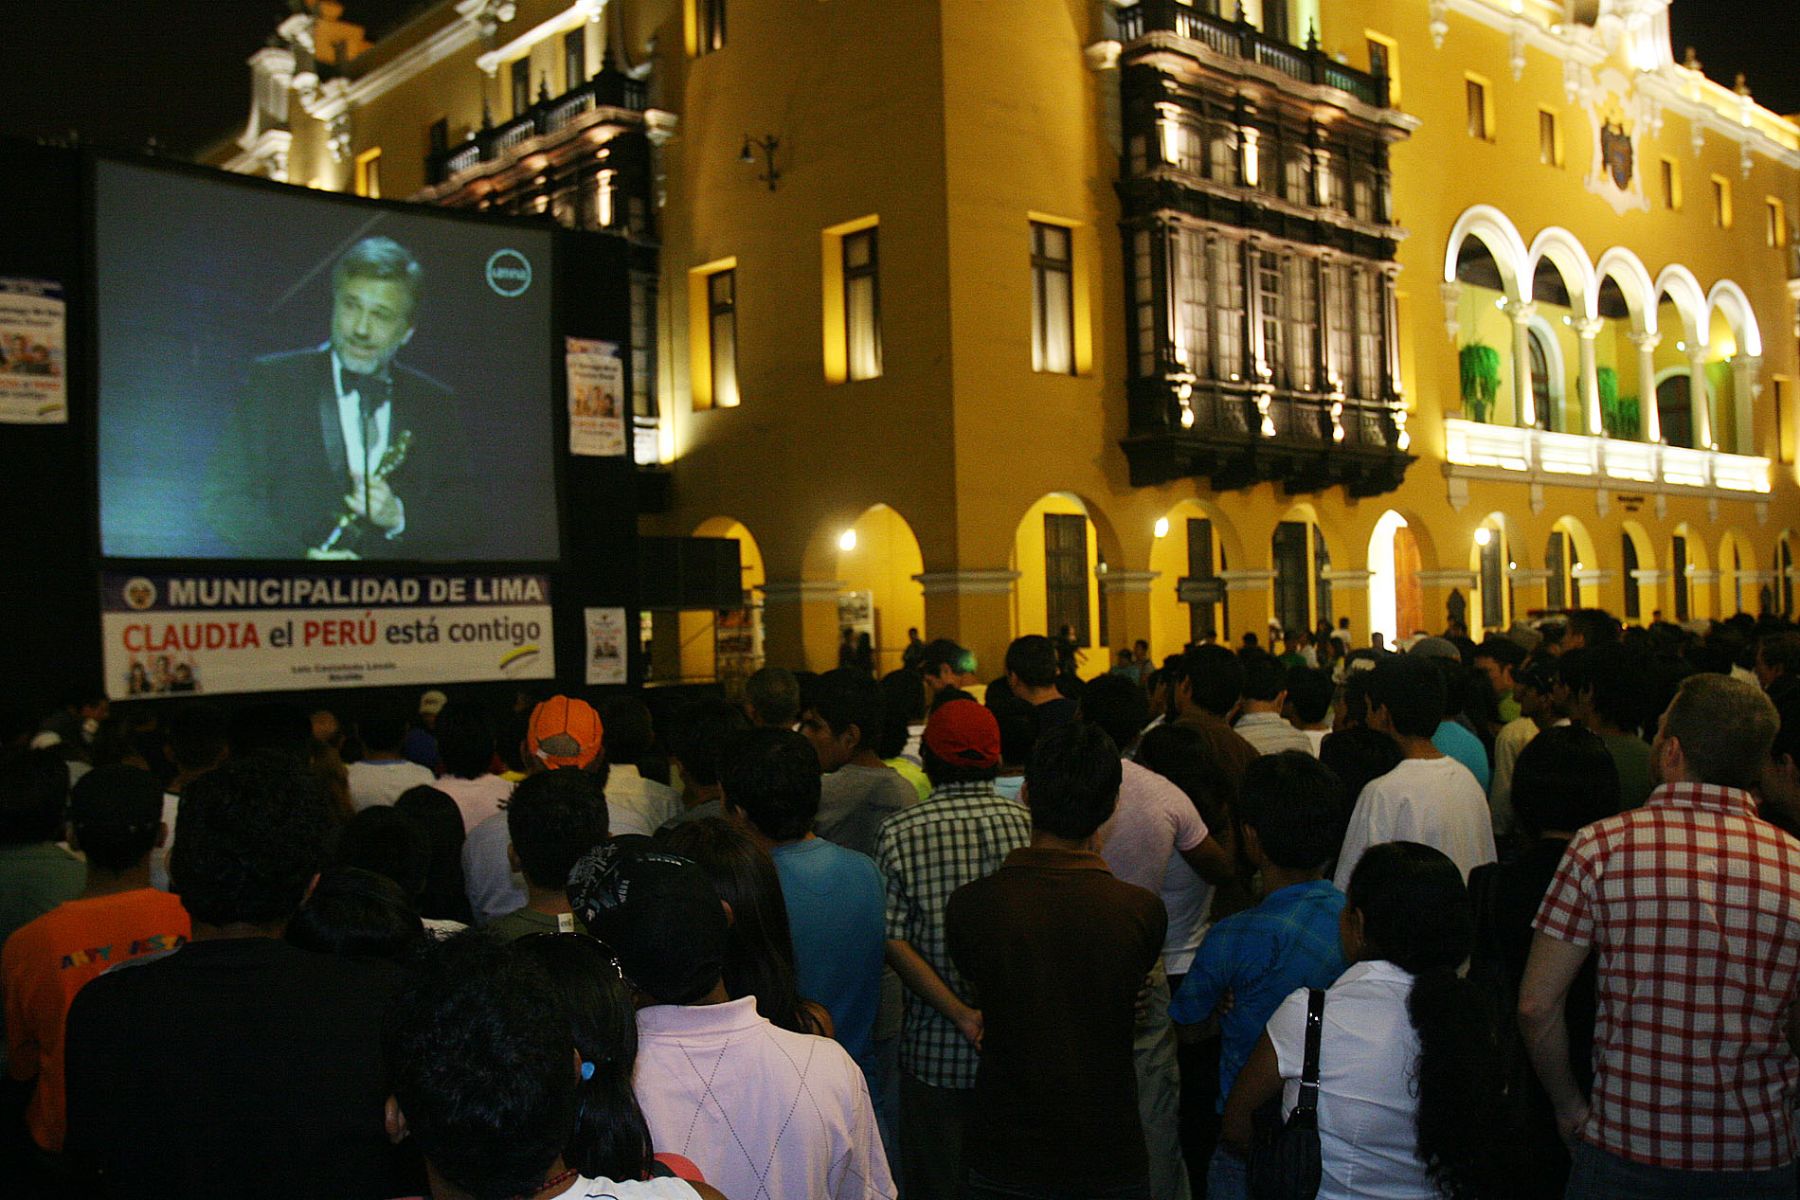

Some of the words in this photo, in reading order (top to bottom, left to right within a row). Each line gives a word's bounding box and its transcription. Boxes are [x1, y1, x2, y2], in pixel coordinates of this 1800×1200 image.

[168, 577, 420, 607] MUNICIPALIDAD
[429, 577, 467, 602] DE
[475, 576, 543, 602] LIMA
[122, 622, 261, 652] CLAUDIA
[269, 620, 293, 647] el
[303, 611, 377, 648] PERÚ
[385, 616, 440, 645] está
[448, 615, 541, 646] contigo
